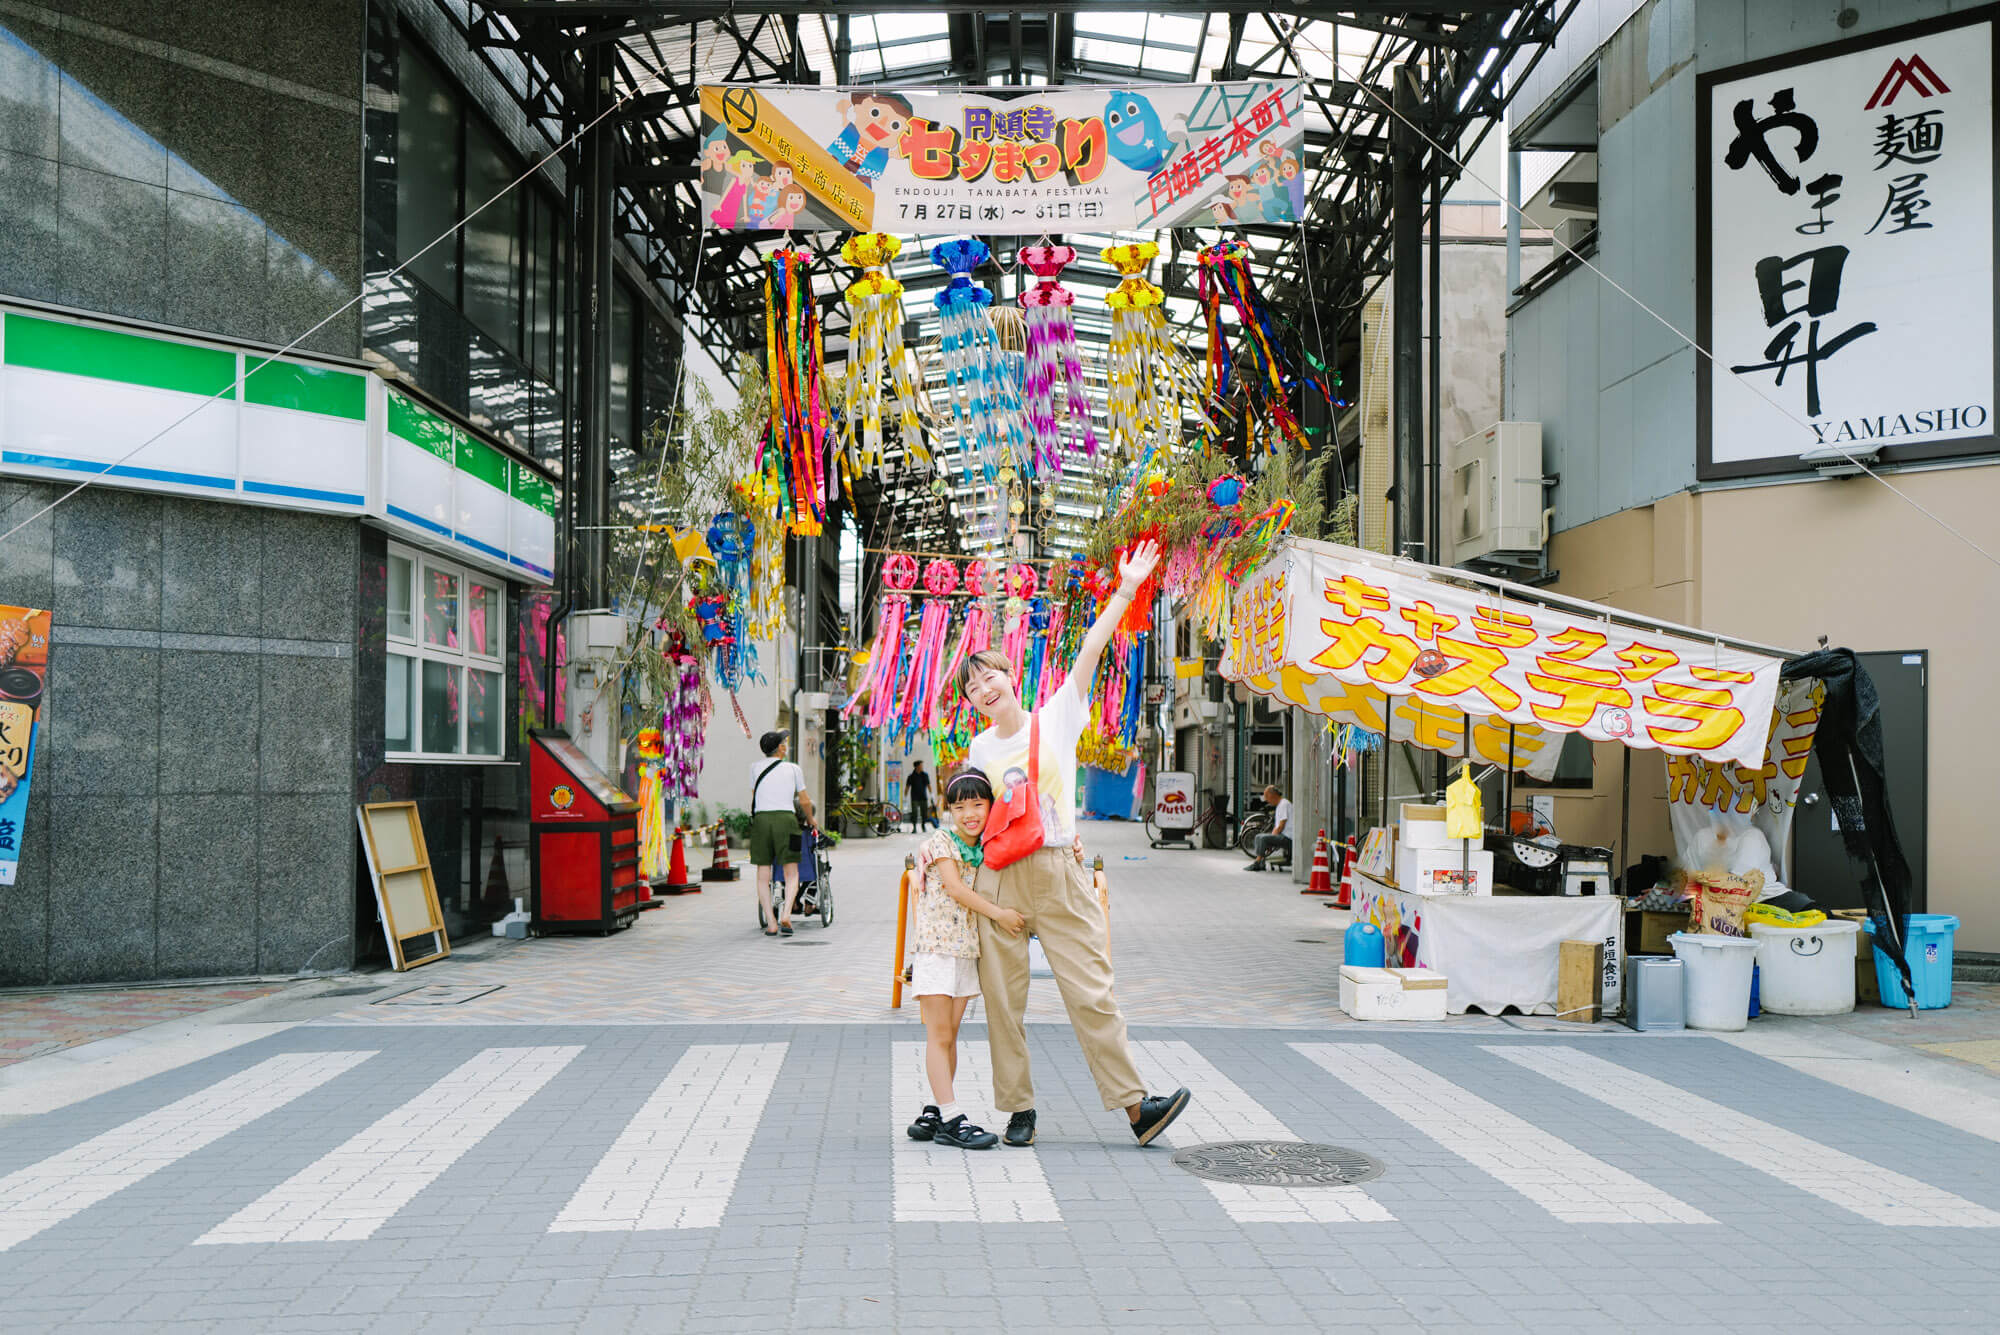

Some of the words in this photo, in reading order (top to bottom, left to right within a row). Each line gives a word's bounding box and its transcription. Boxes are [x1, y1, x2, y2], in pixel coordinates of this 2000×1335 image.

[897, 116, 1108, 185] 七夕まつり
[962, 104, 1058, 142] 円頓寺
[1147, 87, 1291, 218] 円頓寺本町
[759, 122, 864, 221] 円頓寺商店街
[895, 187, 955, 197] ENDOUJI
[968, 188, 1038, 197] TANABATA
[1047, 186, 1110, 196] FESTIVAL
[1864, 109, 1944, 235] 麺屋
[1810, 404, 1987, 445] YAMASHO
[1323, 574, 1756, 685] キャラクター
[1310, 616, 1746, 751] カステラ
[1157, 802, 1193, 814] flutto
[1603, 935, 1617, 988] 石垣食品
